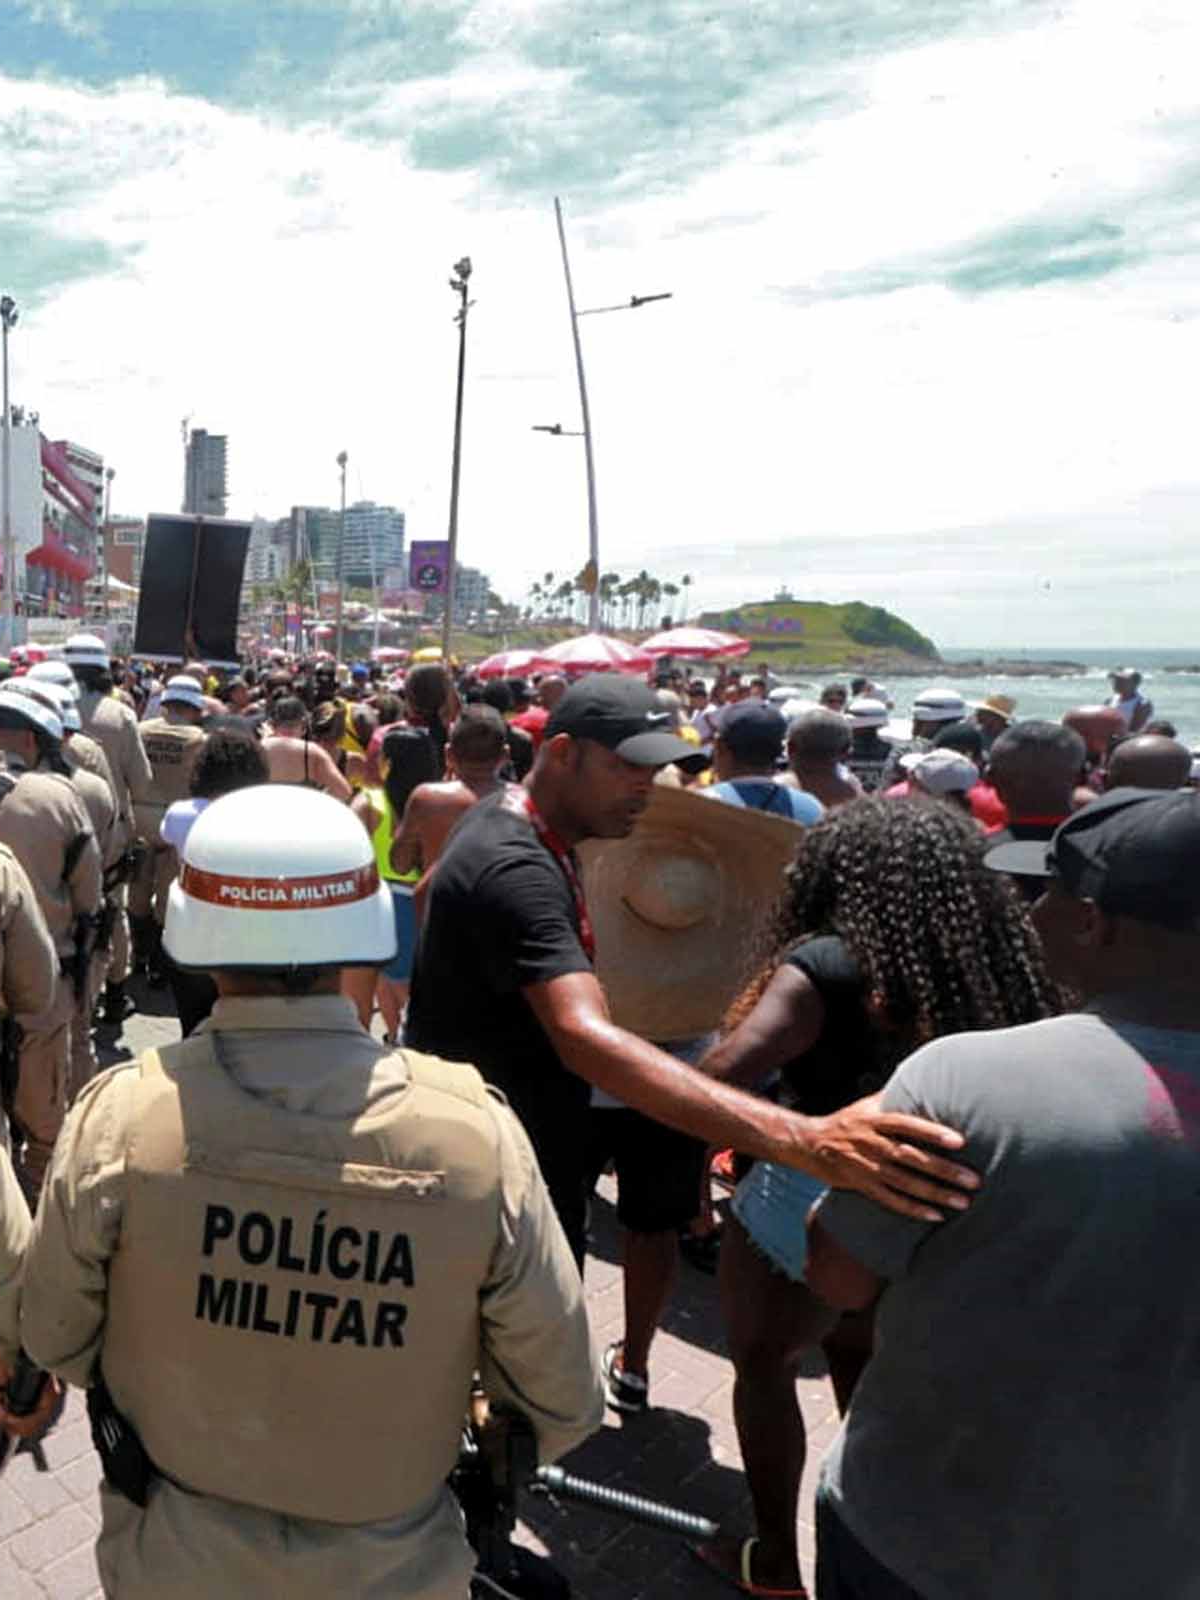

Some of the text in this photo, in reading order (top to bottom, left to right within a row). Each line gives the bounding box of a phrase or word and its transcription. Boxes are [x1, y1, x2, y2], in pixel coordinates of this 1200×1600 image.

[219, 879, 355, 902] POLÍCIA MILITAR
[202, 1204, 415, 1288] POLÍCIA
[195, 1272, 408, 1349] MILITAR
